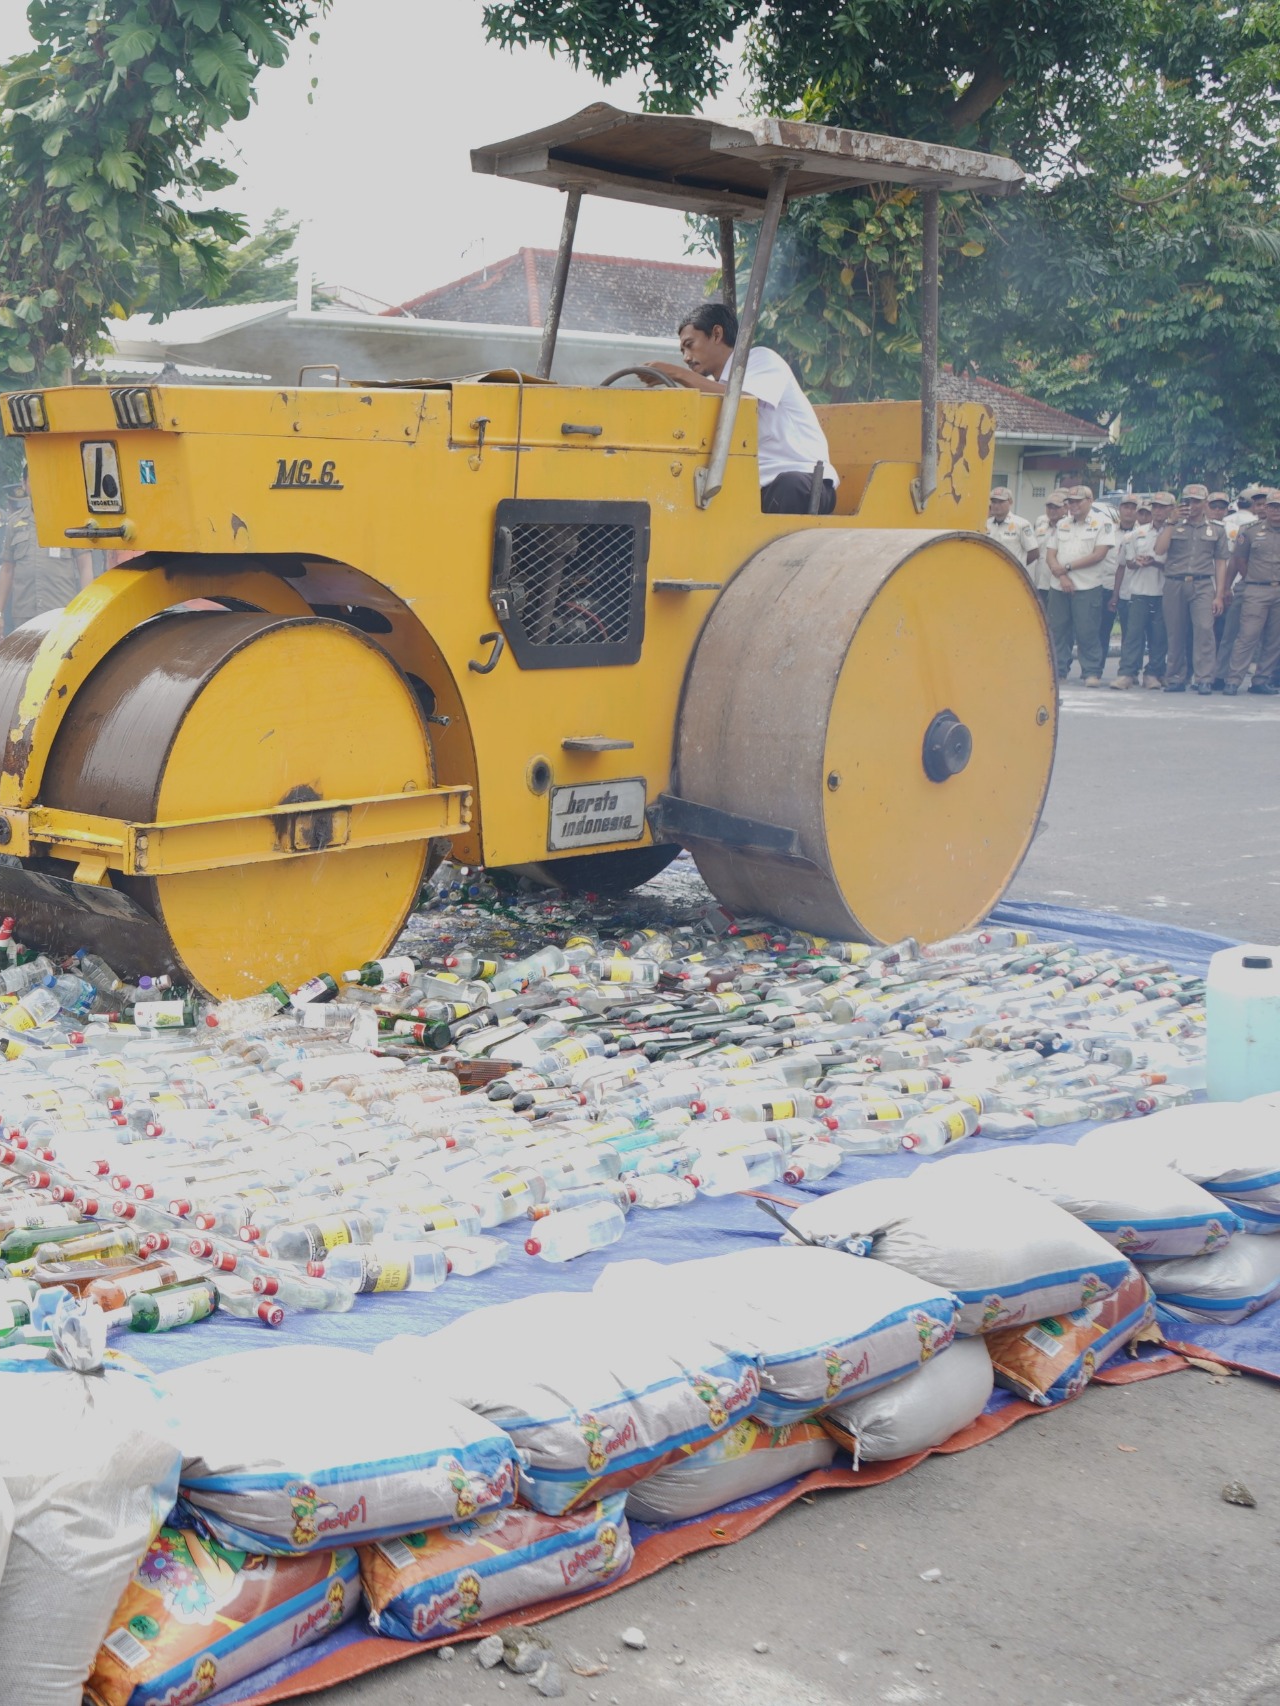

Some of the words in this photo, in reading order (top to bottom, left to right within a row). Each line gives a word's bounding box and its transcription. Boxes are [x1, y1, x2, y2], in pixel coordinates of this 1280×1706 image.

[556, 790, 619, 816] barata
[561, 815, 639, 837] indonesia
[318, 1496, 367, 1532] Lahap
[561, 1543, 602, 1586] Lahap
[291, 1599, 332, 1648] Lahap
